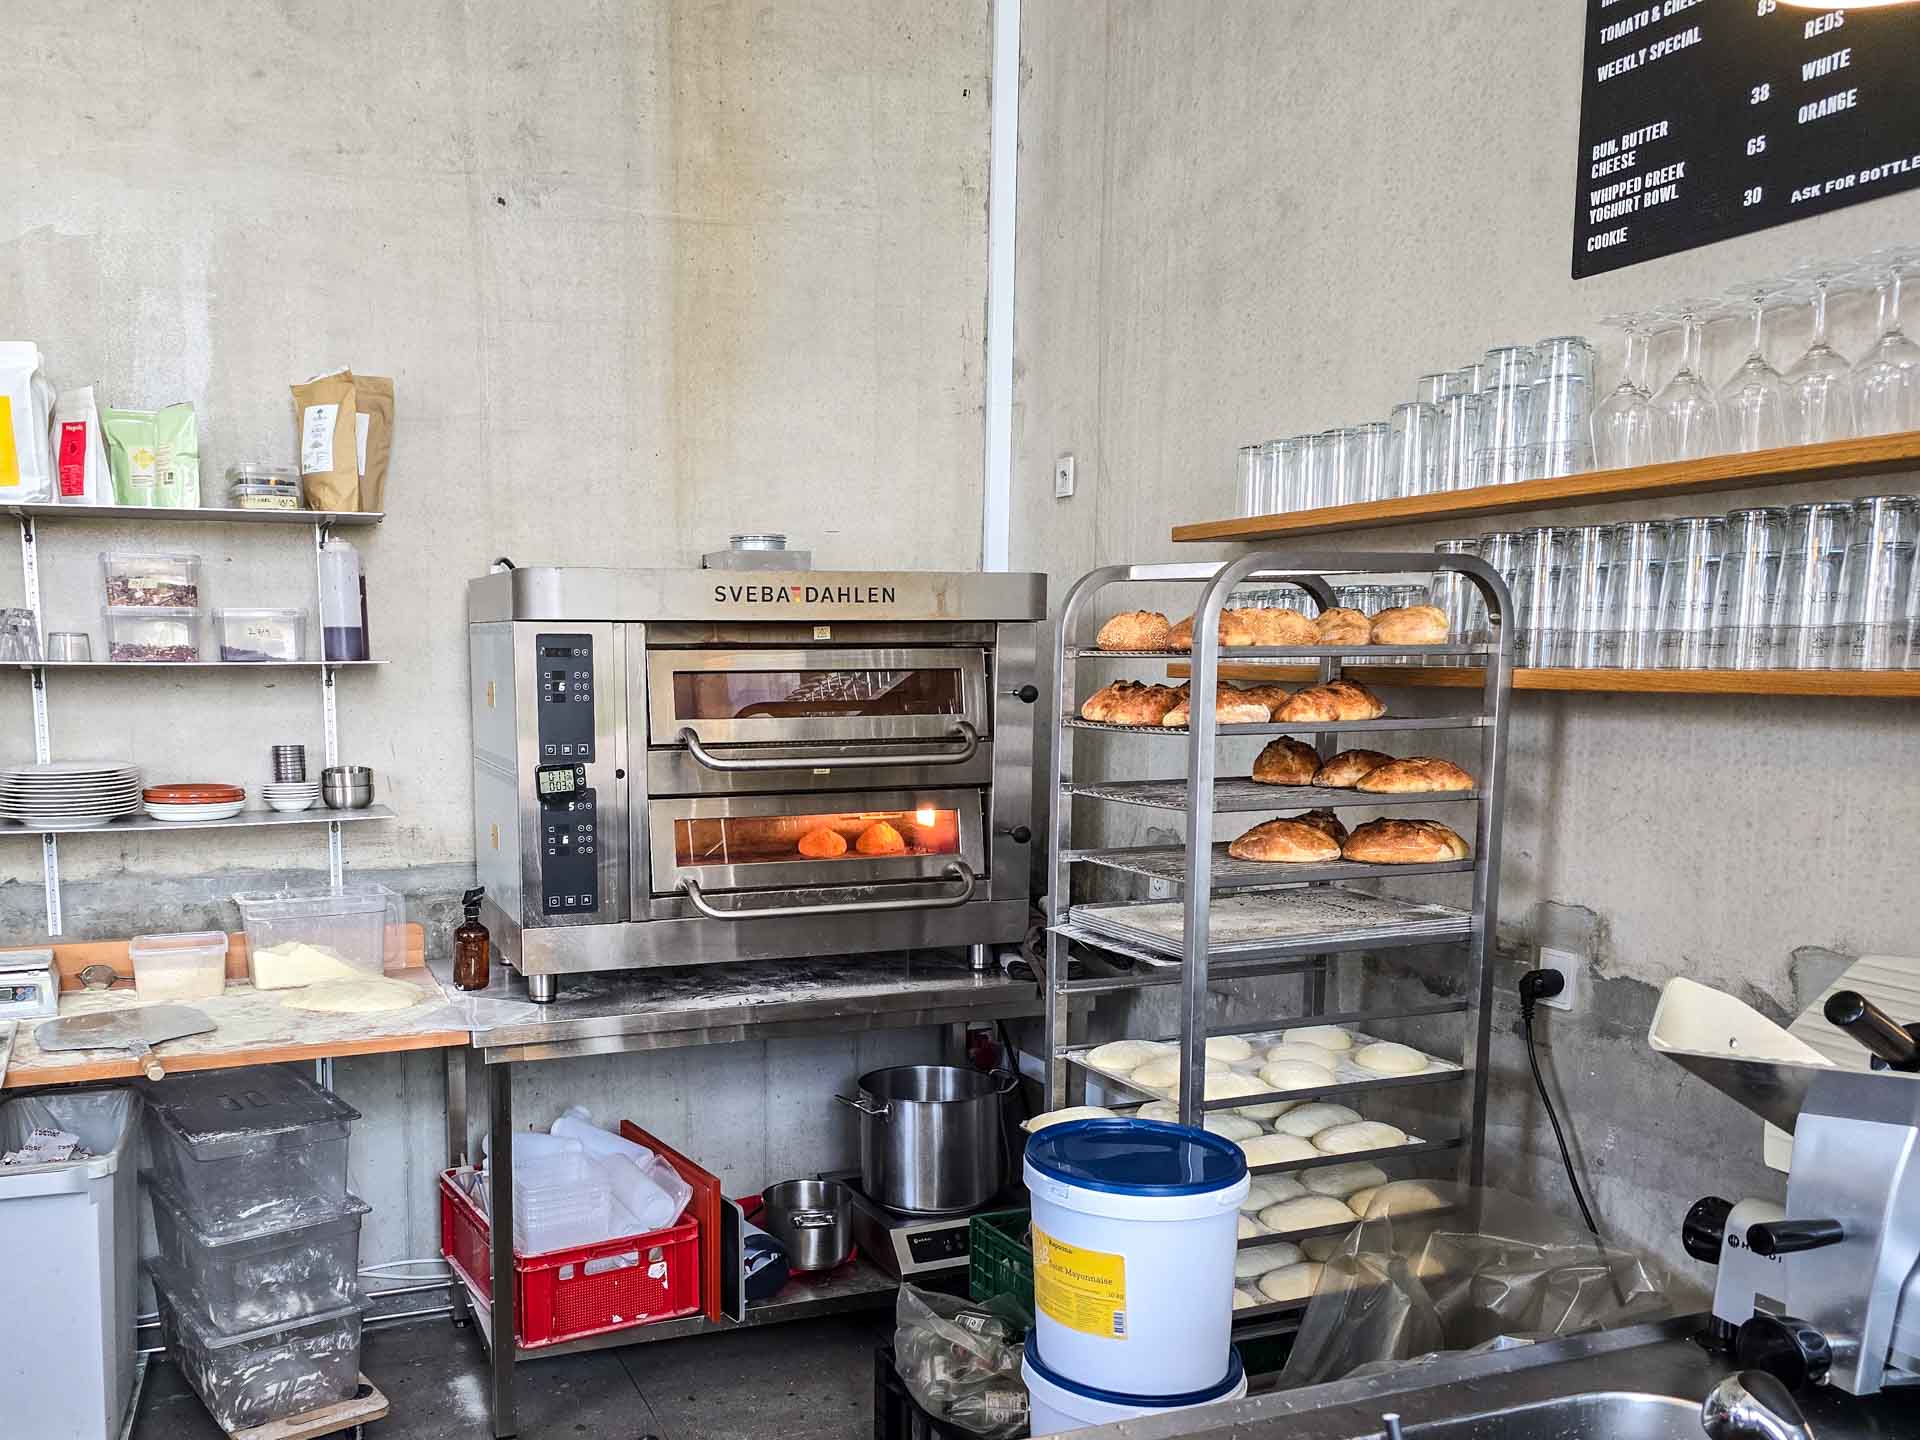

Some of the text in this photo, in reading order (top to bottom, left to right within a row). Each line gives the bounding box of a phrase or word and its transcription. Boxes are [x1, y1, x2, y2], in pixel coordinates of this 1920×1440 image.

[1600, 10, 1649, 44] TOMATO
[1651, 5, 1661, 22] &
[1804, 10, 1845, 39] REDS
[1597, 26, 1702, 82] WEEKLY SPECIAL
[1802, 48, 1851, 81] WHITE
[1750, 83, 1770, 105] 38
[1798, 88, 1858, 124] ORANGE
[1621, 120, 1668, 150] BUTTER
[1747, 135, 1766, 156] 65
[1591, 150, 1637, 178] CHEESE
[1590, 161, 1685, 206] WHIPPED GREEK
[1743, 186, 1762, 206] 30
[1791, 184, 1821, 203] ASK
[1825, 174, 1856, 193] FOR
[1590, 183, 1679, 224] YOGHURT BOWL
[1587, 226, 1629, 252] COOKIE
[714, 585, 896, 603] SVEBA DAHLEN
